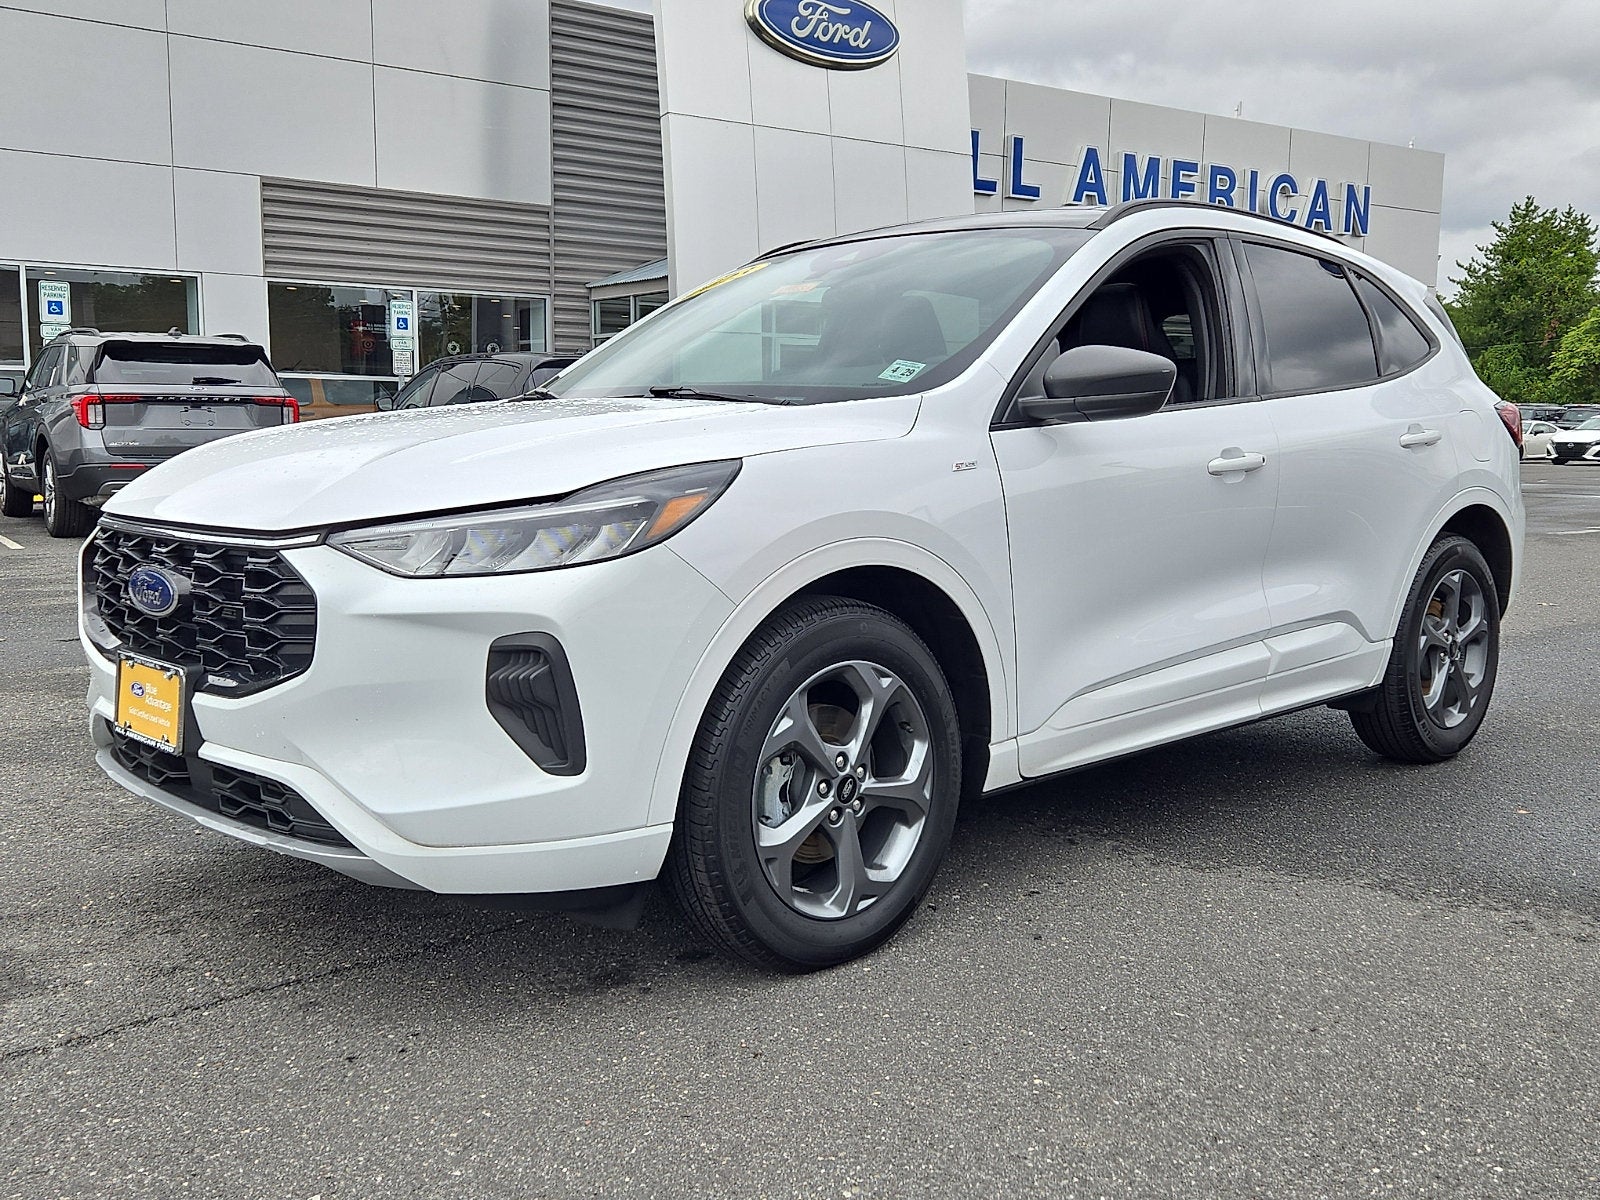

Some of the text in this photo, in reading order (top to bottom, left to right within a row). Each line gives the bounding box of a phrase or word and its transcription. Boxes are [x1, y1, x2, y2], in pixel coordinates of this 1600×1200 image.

[790, 0, 872, 49] Ford
[1069, 143, 1372, 237] AMERICAN
[41, 284, 68, 292] RESERVED
[891, 366, 901, 374] 4
[900, 367, 916, 377] 29
[135, 574, 163, 605] Ford
[126, 731, 156, 747] AMERICAN
[156, 742, 175, 753] FORD
